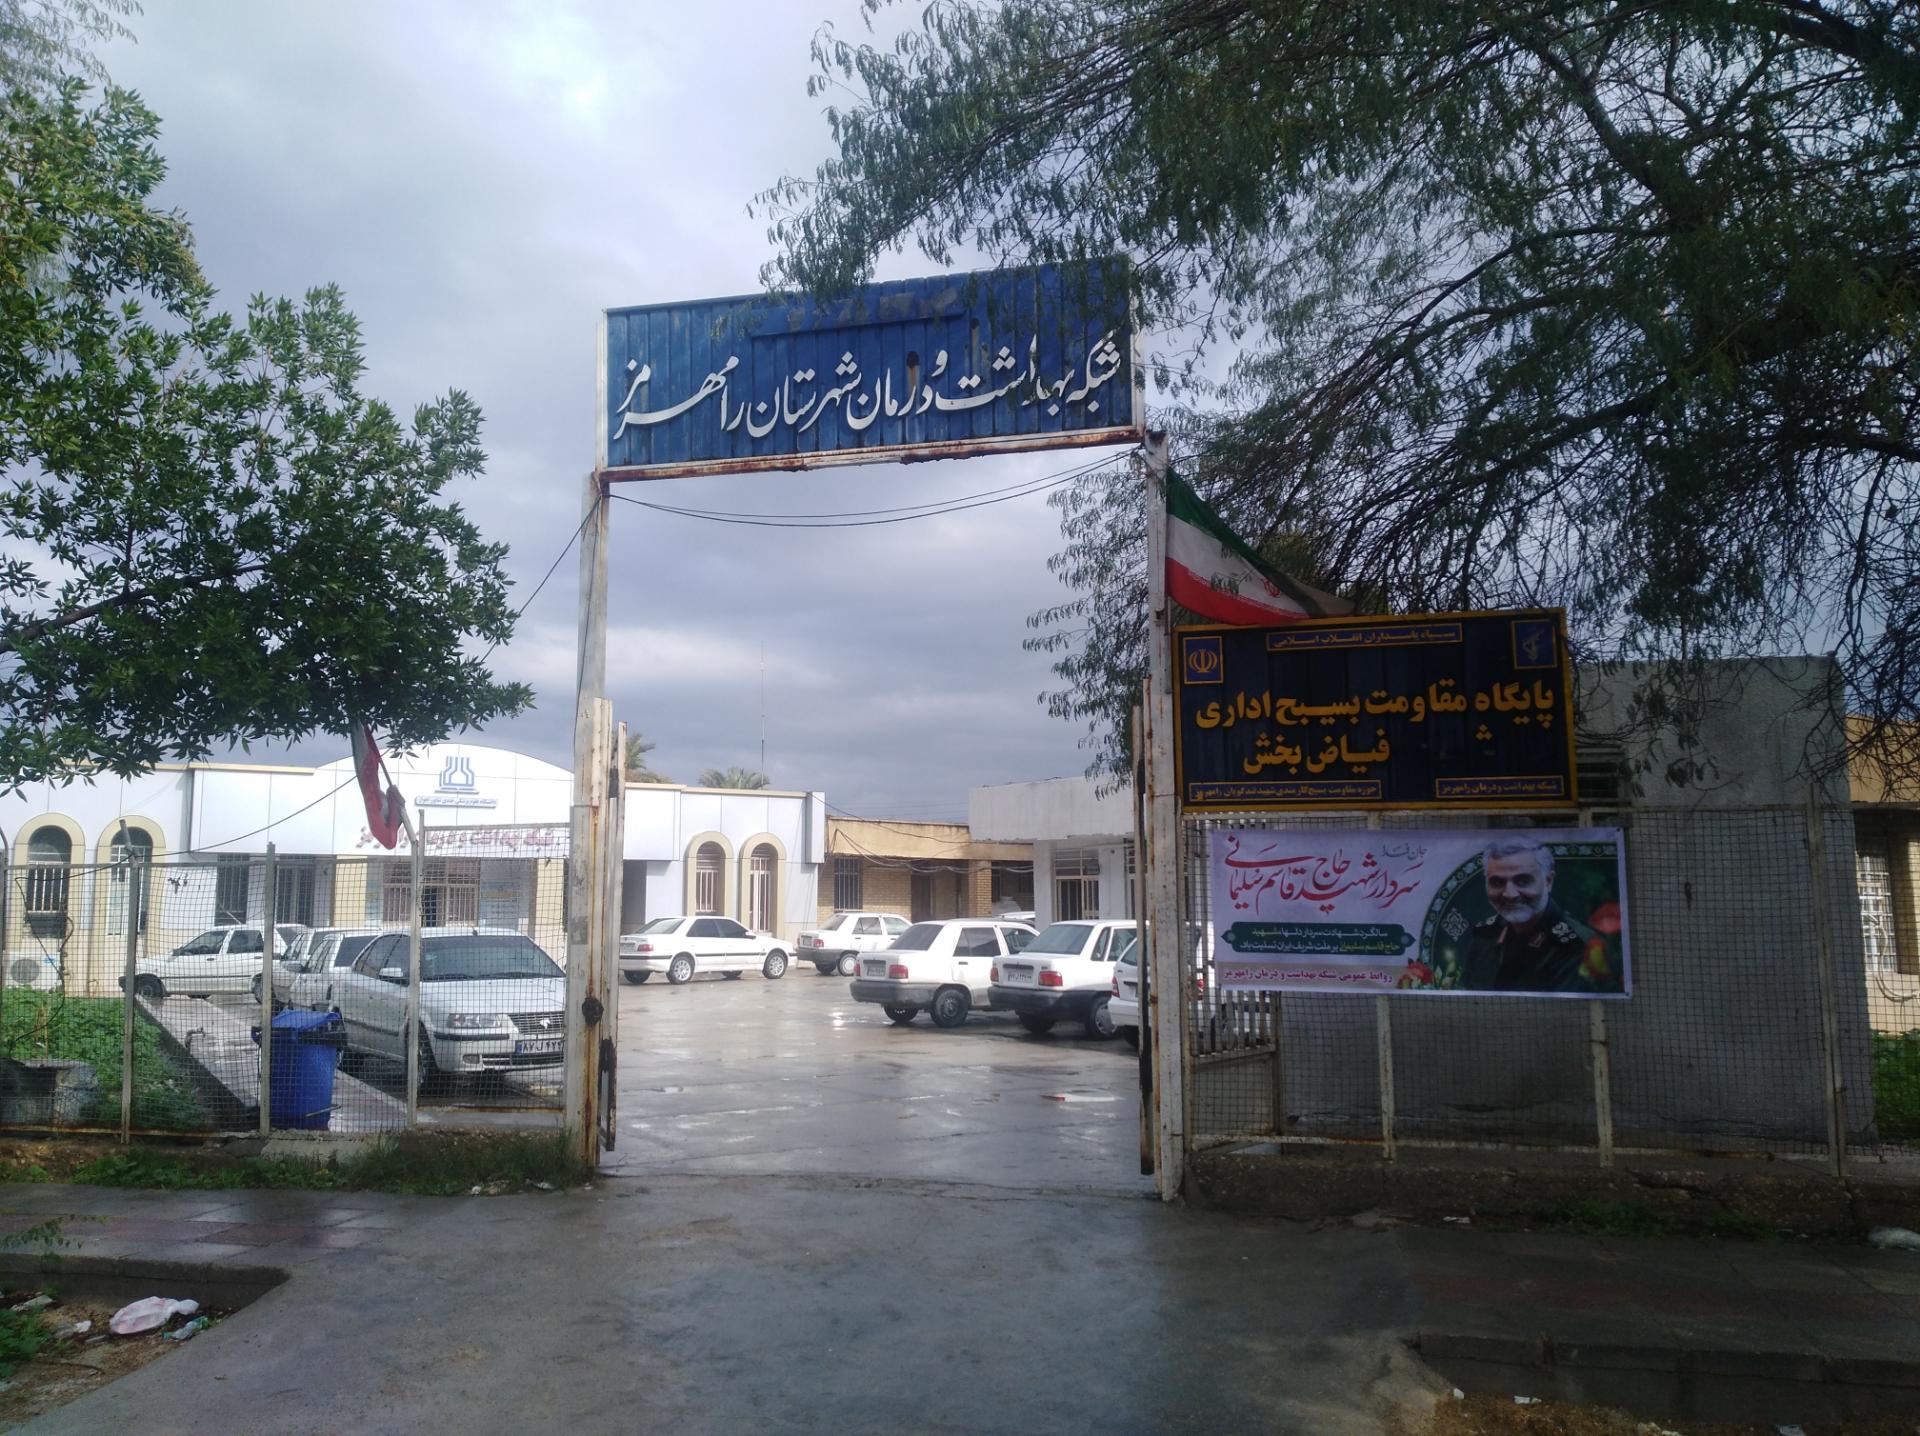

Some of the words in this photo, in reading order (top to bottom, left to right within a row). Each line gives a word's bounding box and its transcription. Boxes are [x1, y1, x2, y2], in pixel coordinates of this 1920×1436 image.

[931, 349, 949, 378] و
[935, 333, 1075, 417] بهداشت
[1065, 329, 1122, 413] شبکه
[613, 355, 745, 440] رامهرمز
[746, 351, 863, 439] شهرستان
[846, 366, 933, 431] درمان
[1195, 689, 1271, 729] اداری
[1276, 696, 1361, 726] بسیج
[1365, 678, 1467, 722] مقاومت
[1474, 679, 1554, 729] پایگاه
[1243, 732, 1302, 775] بخش
[1306, 728, 1390, 774] فیاض
[1224, 834, 1320, 910] سلیمانی
[1255, 866, 1308, 916] قاسم
[1293, 852, 1382, 916] شهید
[1312, 848, 1352, 891] حاج
[1362, 862, 1424, 909] سردار
